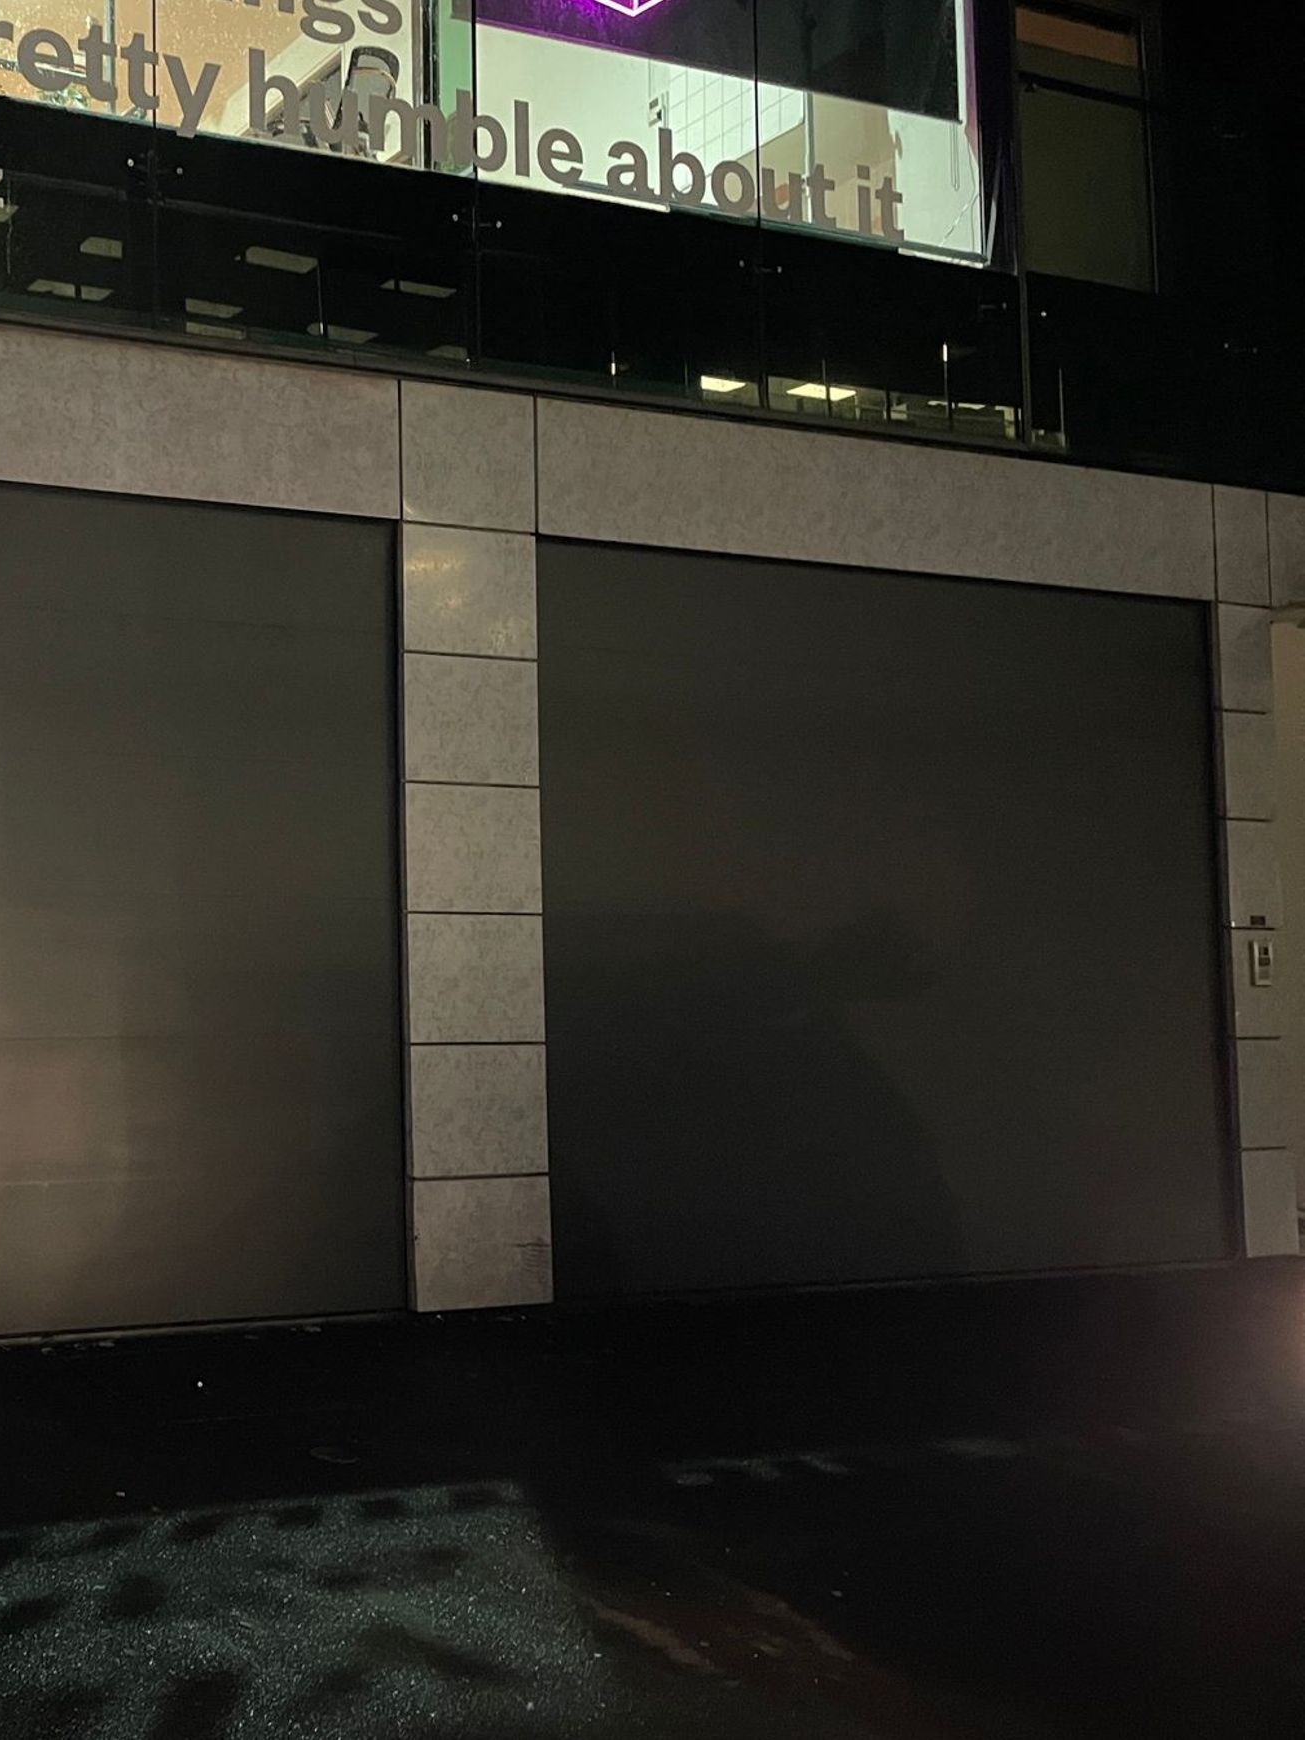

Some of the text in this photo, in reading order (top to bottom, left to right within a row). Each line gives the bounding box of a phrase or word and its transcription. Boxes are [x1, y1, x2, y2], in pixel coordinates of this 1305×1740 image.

[248, 47, 584, 187] humble
[607, 127, 837, 225] about
[856, 164, 905, 242] it
